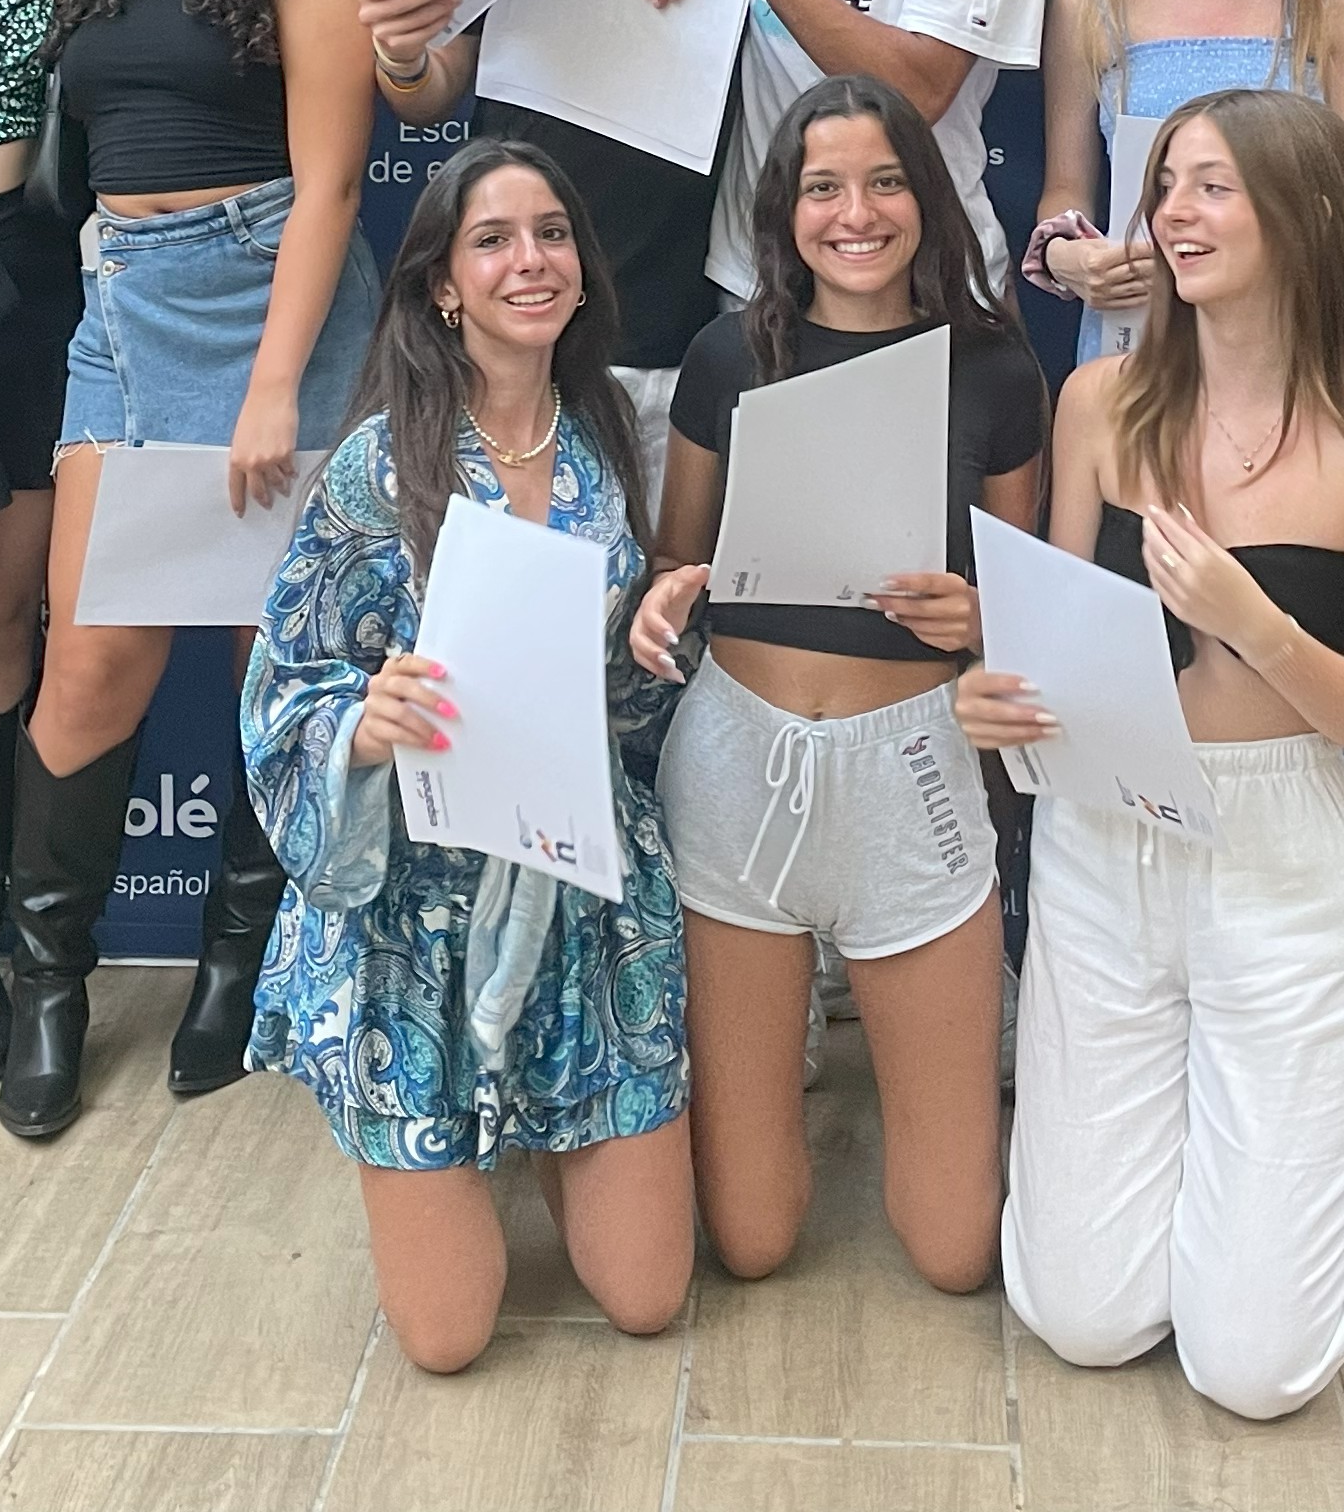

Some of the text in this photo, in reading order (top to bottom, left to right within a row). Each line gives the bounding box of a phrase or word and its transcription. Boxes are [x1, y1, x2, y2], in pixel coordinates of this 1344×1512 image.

[368, 151, 413, 183] de
[909, 754, 970, 876] HOLLISTER
[113, 869, 210, 901] spañol
